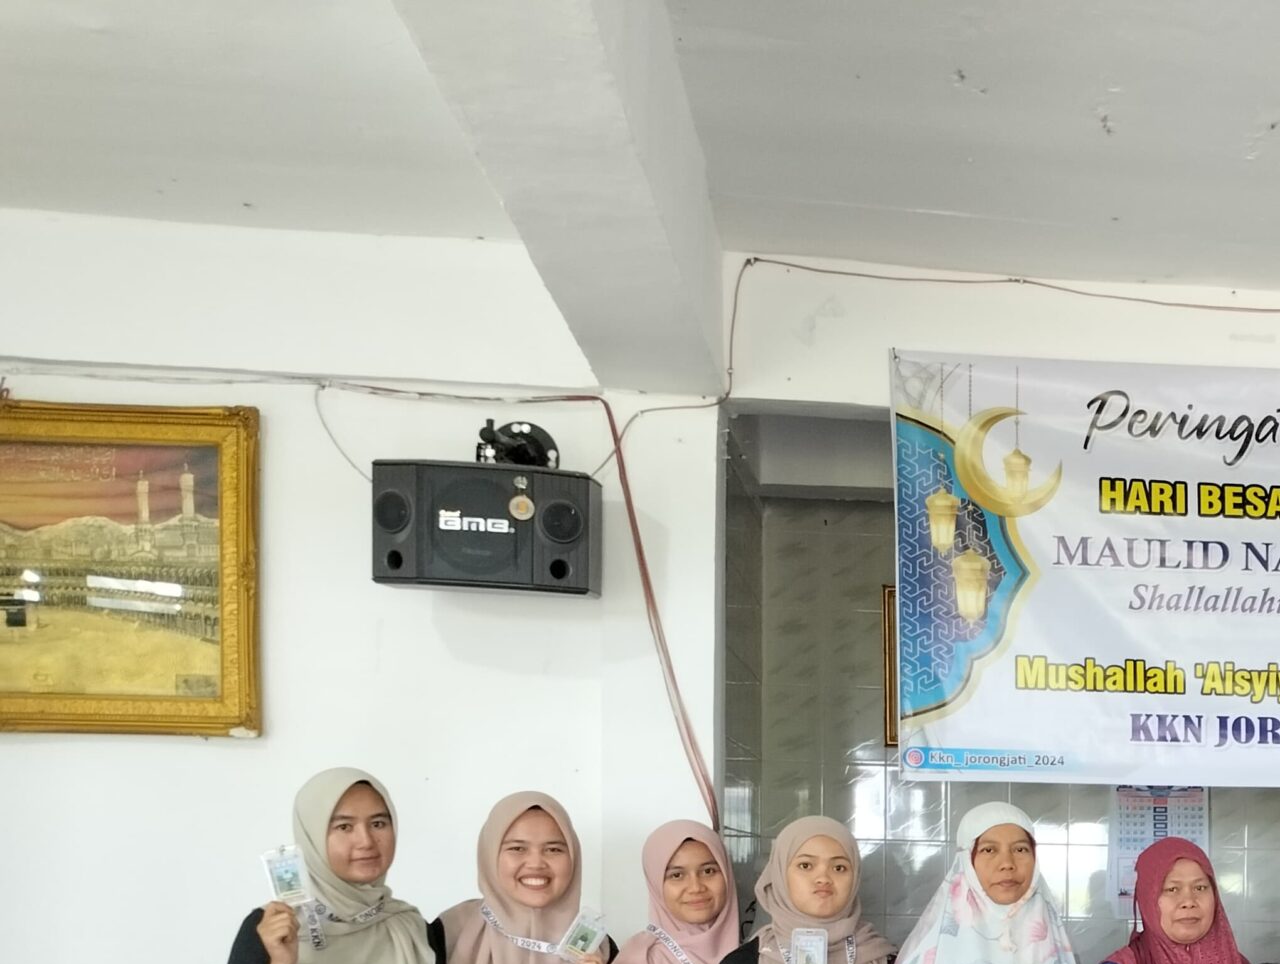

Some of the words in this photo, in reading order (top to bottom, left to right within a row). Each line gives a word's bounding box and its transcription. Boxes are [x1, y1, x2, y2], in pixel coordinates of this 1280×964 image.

[1099, 477, 1188, 516] HARI
[1052, 535, 1230, 573] MAULID
[1015, 655, 1186, 694] Mushallah
[1129, 713, 1204, 744] KKN
